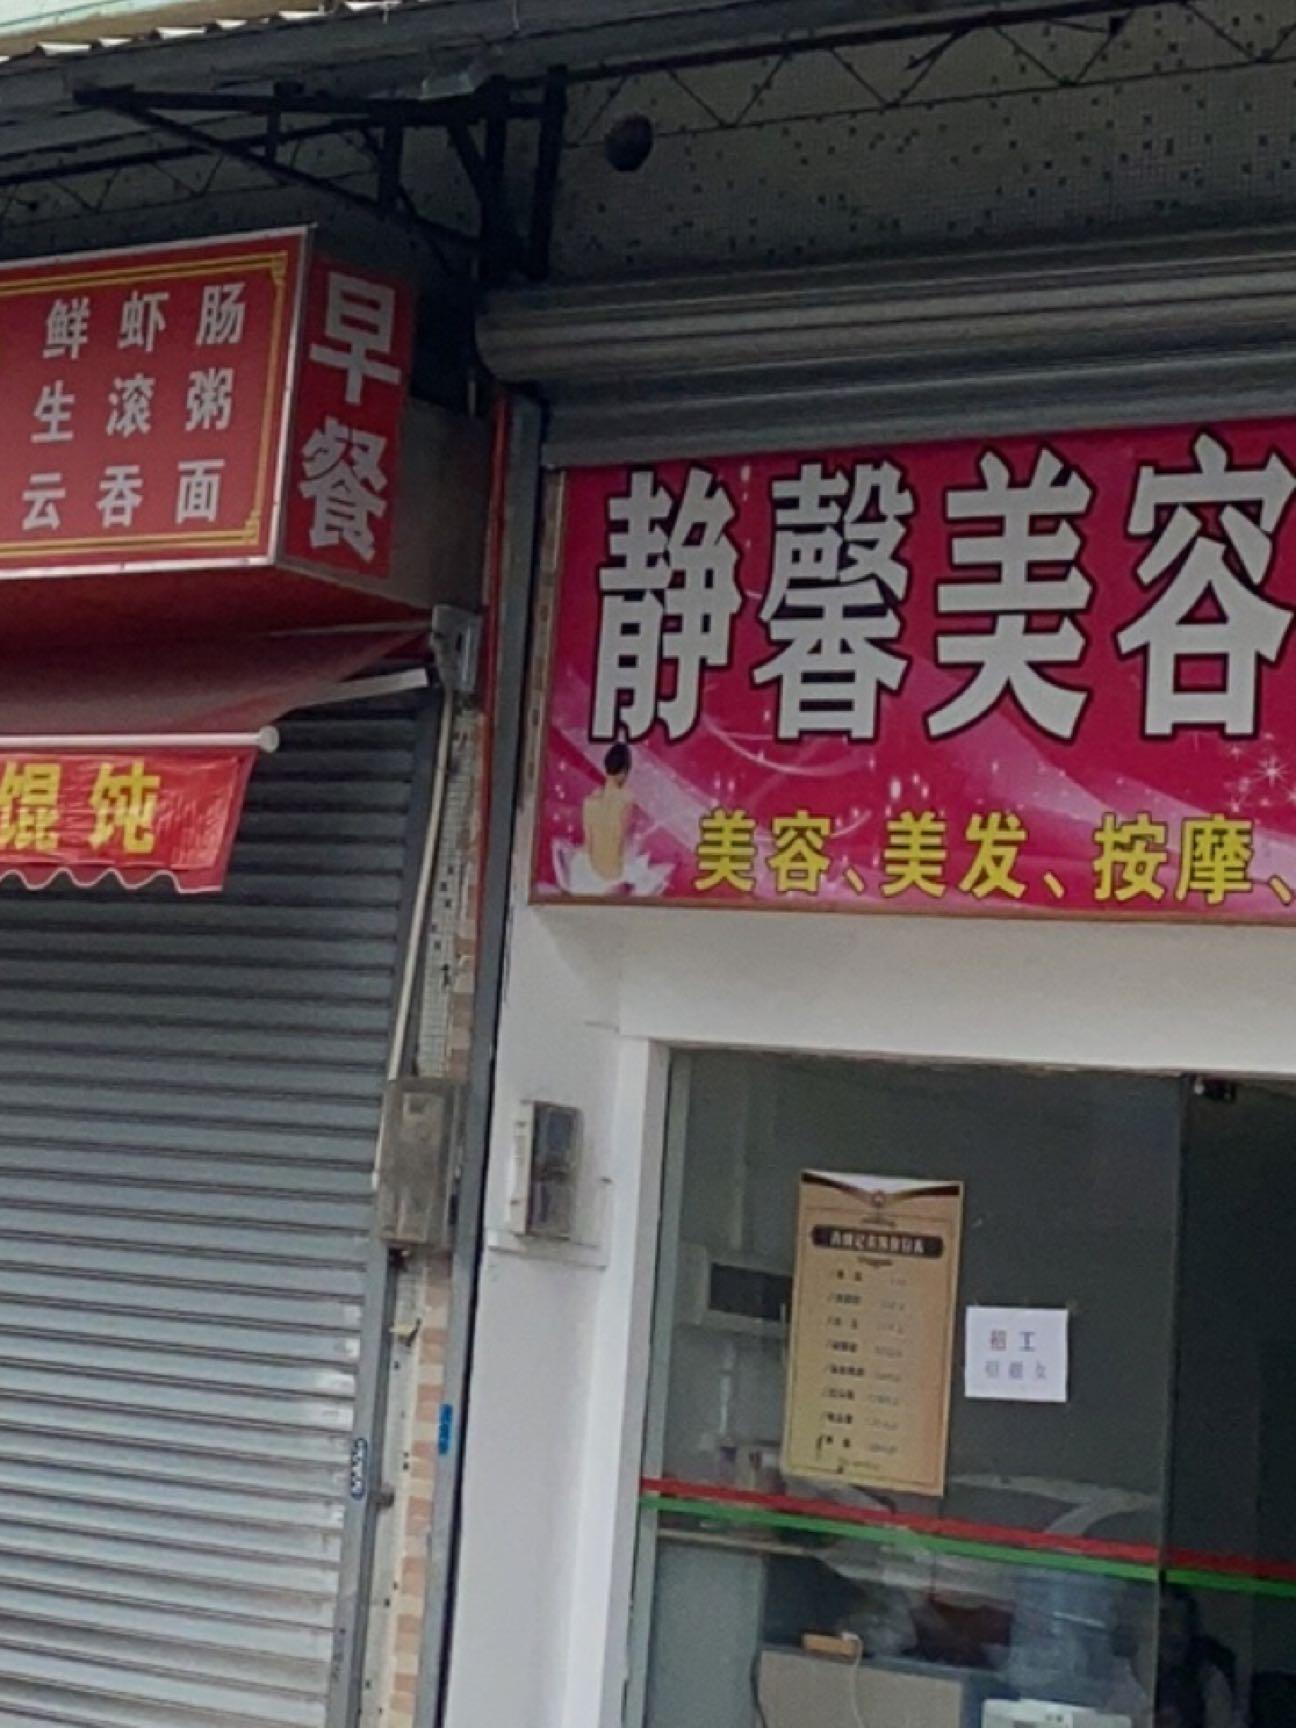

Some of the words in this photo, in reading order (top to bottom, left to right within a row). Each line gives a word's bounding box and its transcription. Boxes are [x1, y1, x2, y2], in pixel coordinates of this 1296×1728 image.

[43, 282, 245, 359] 鲜虾肠
[31, 368, 234, 443] 生滚粥
[300, 272, 401, 562] 早餐
[22, 459, 225, 530] 云吞面
[590, 432, 1296, 741] 静馨美容
